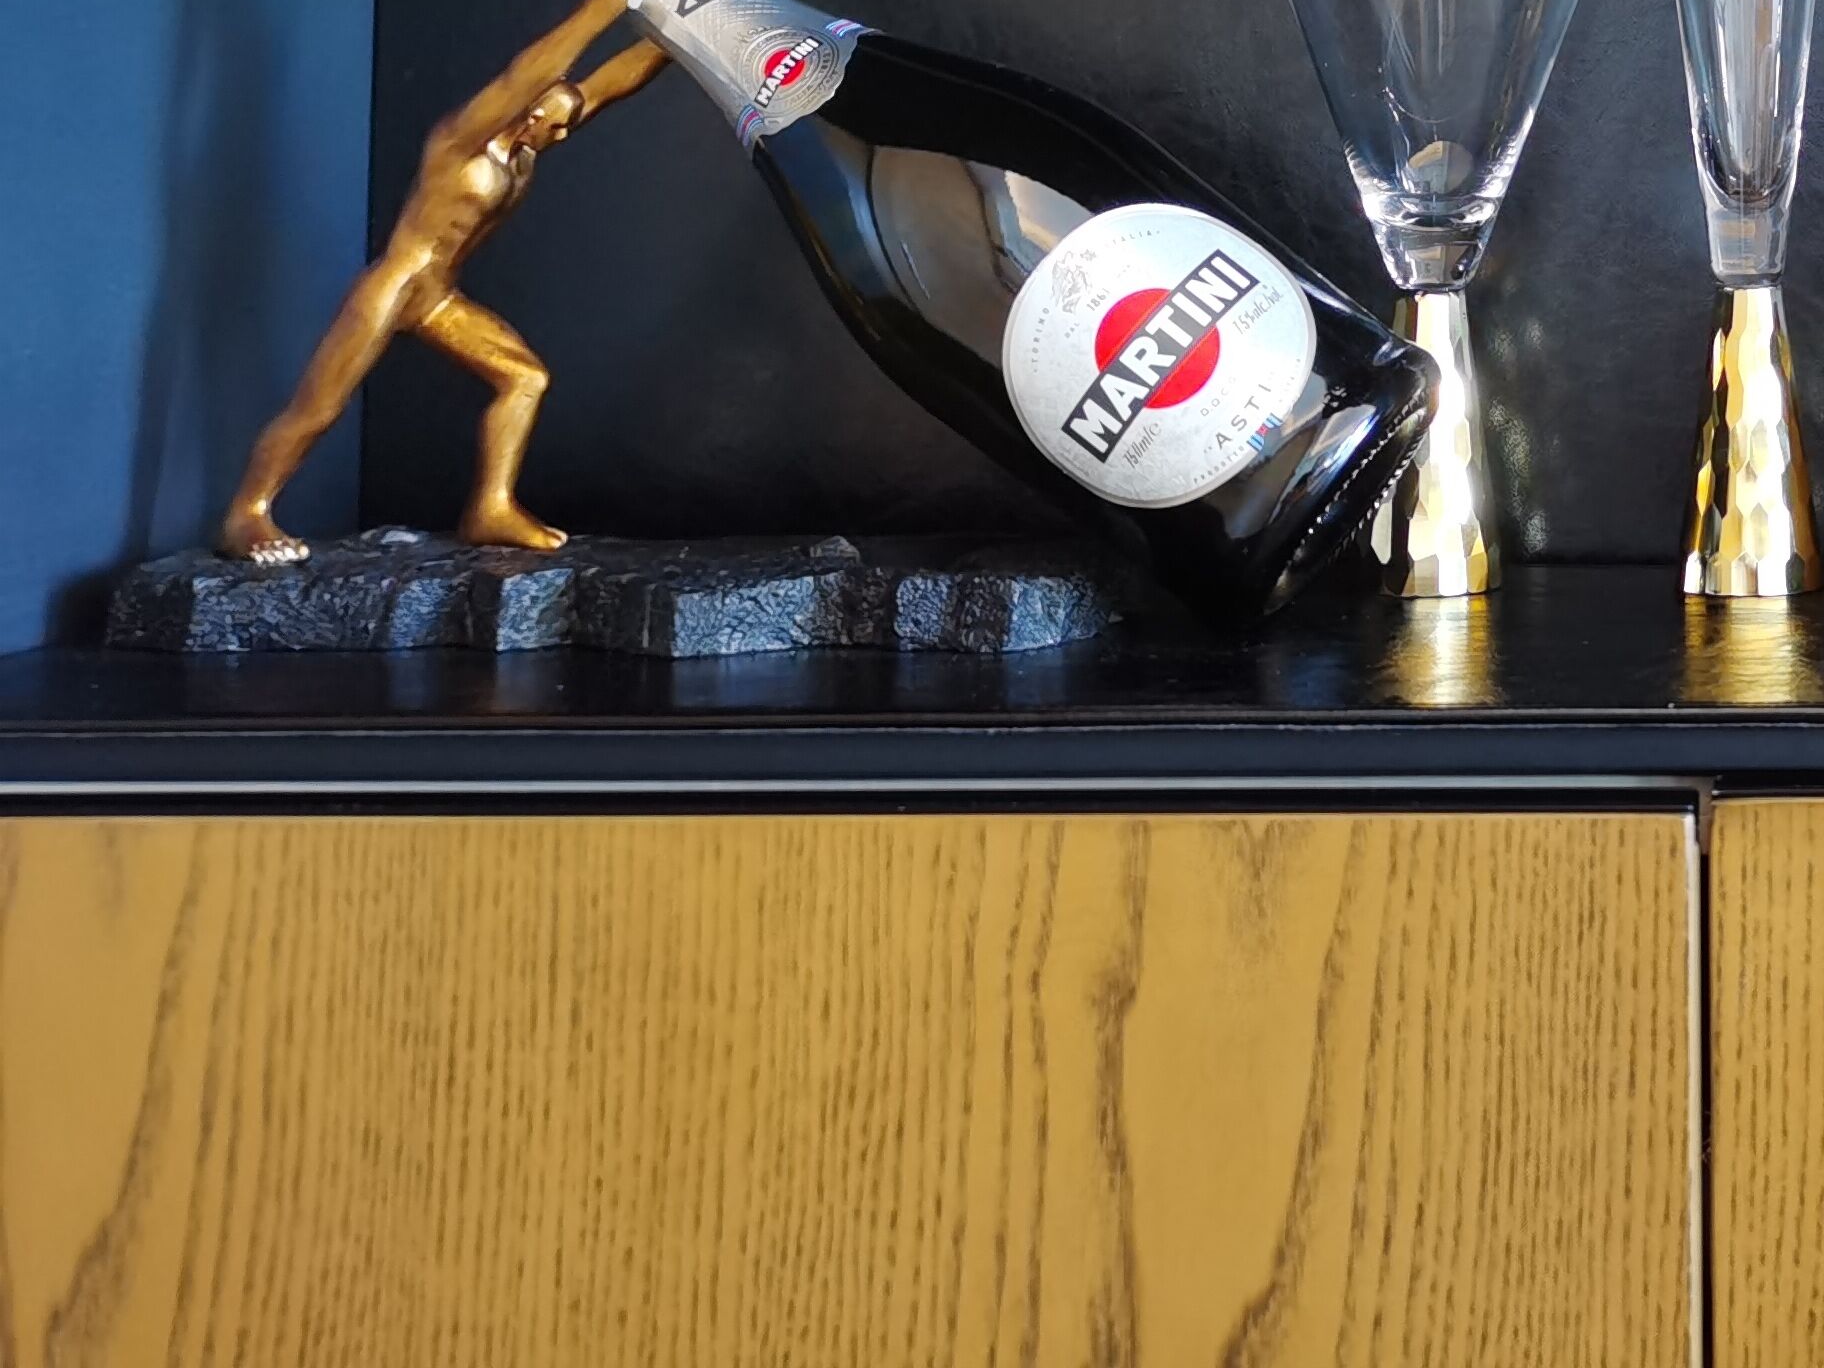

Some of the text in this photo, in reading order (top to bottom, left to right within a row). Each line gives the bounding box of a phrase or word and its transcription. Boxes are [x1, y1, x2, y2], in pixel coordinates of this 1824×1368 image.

[755, 37, 820, 107] MARTINI
[1103, 229, 1152, 248] TALIA
[1031, 307, 1050, 364] TORINO
[1070, 255, 1250, 454] MARTINI
[1214, 383, 1272, 450] ASTI
